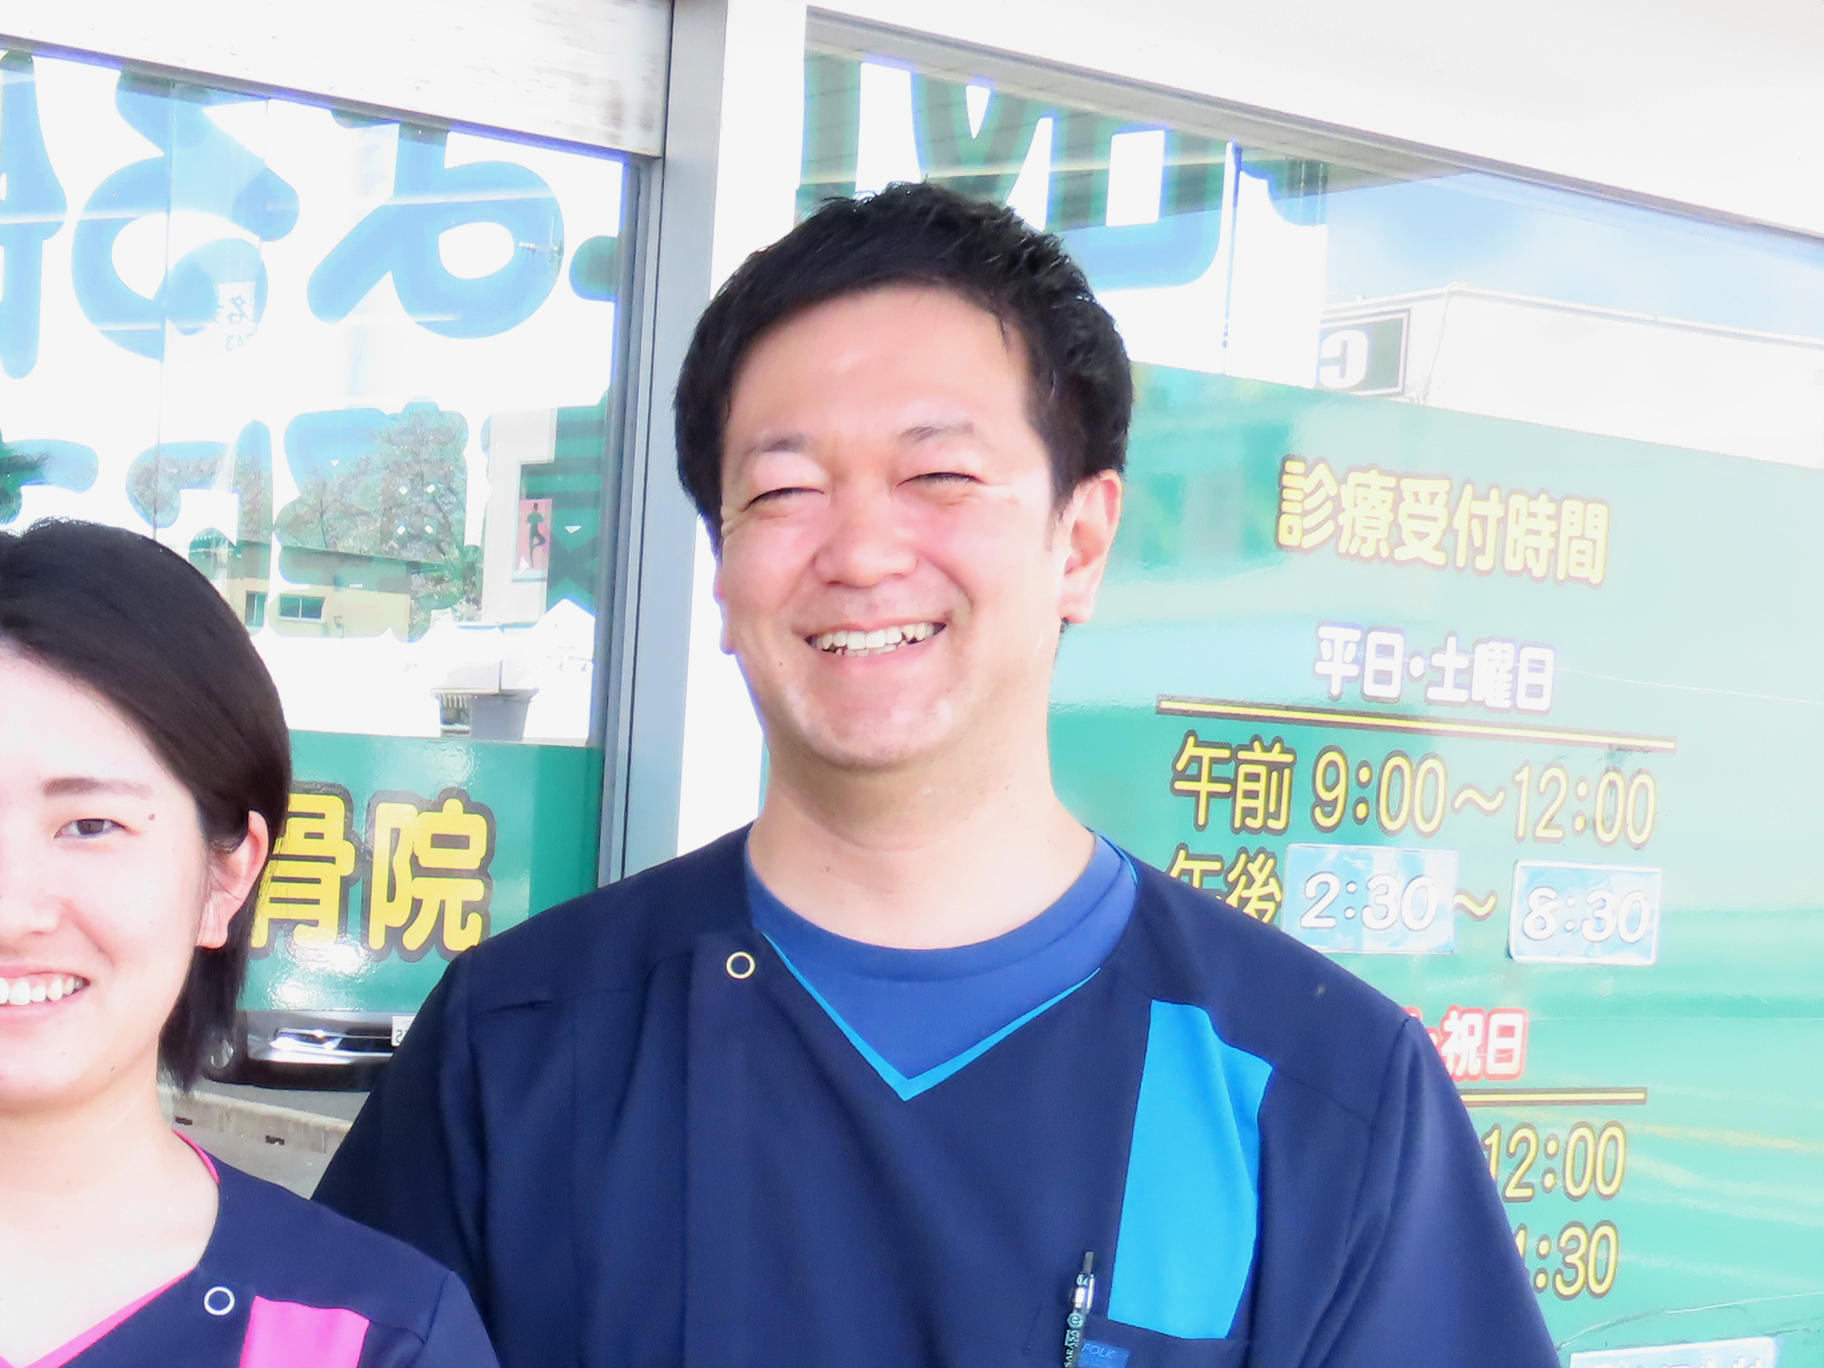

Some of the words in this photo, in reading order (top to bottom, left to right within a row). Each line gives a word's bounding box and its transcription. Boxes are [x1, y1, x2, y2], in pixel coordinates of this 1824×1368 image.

[1279, 457, 1609, 583] 診療受付時間
[1316, 623, 1556, 711] 平日・土曜日
[1171, 733, 1295, 832] 午前
[1083, 1344, 1115, 1357] FOLK
